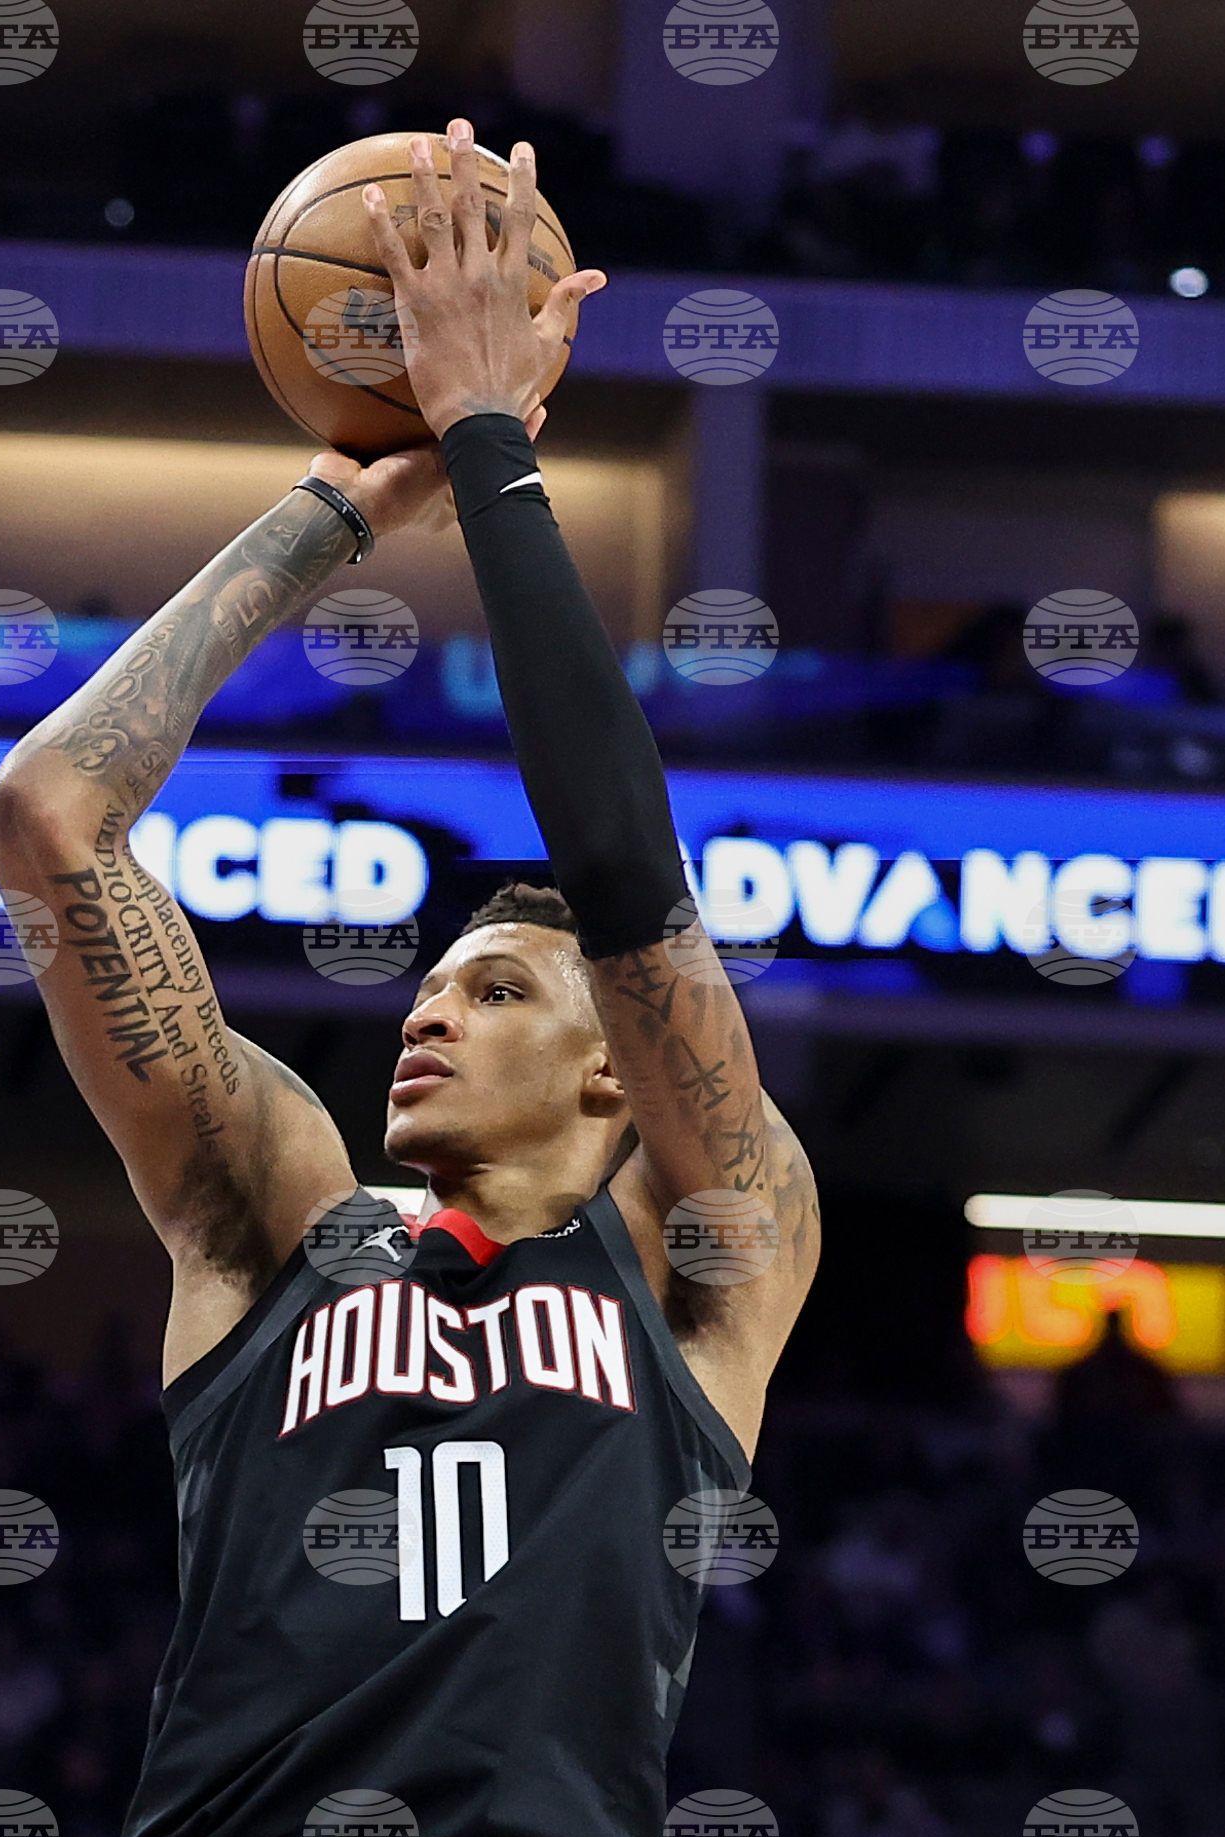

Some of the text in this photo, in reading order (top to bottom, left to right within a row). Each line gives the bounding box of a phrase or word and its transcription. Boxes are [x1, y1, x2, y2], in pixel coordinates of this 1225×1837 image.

[47, 868, 170, 1083] POTENTIAL
[93, 804, 176, 998] MEDIOCRITY
[154, 1004, 198, 1060] And
[678, 836, 1225, 963] DVANCE
[195, 997, 241, 1096] Breeds
[278, 1279, 637, 1437] HOUSTON
[383, 1440, 510, 1621] 10
